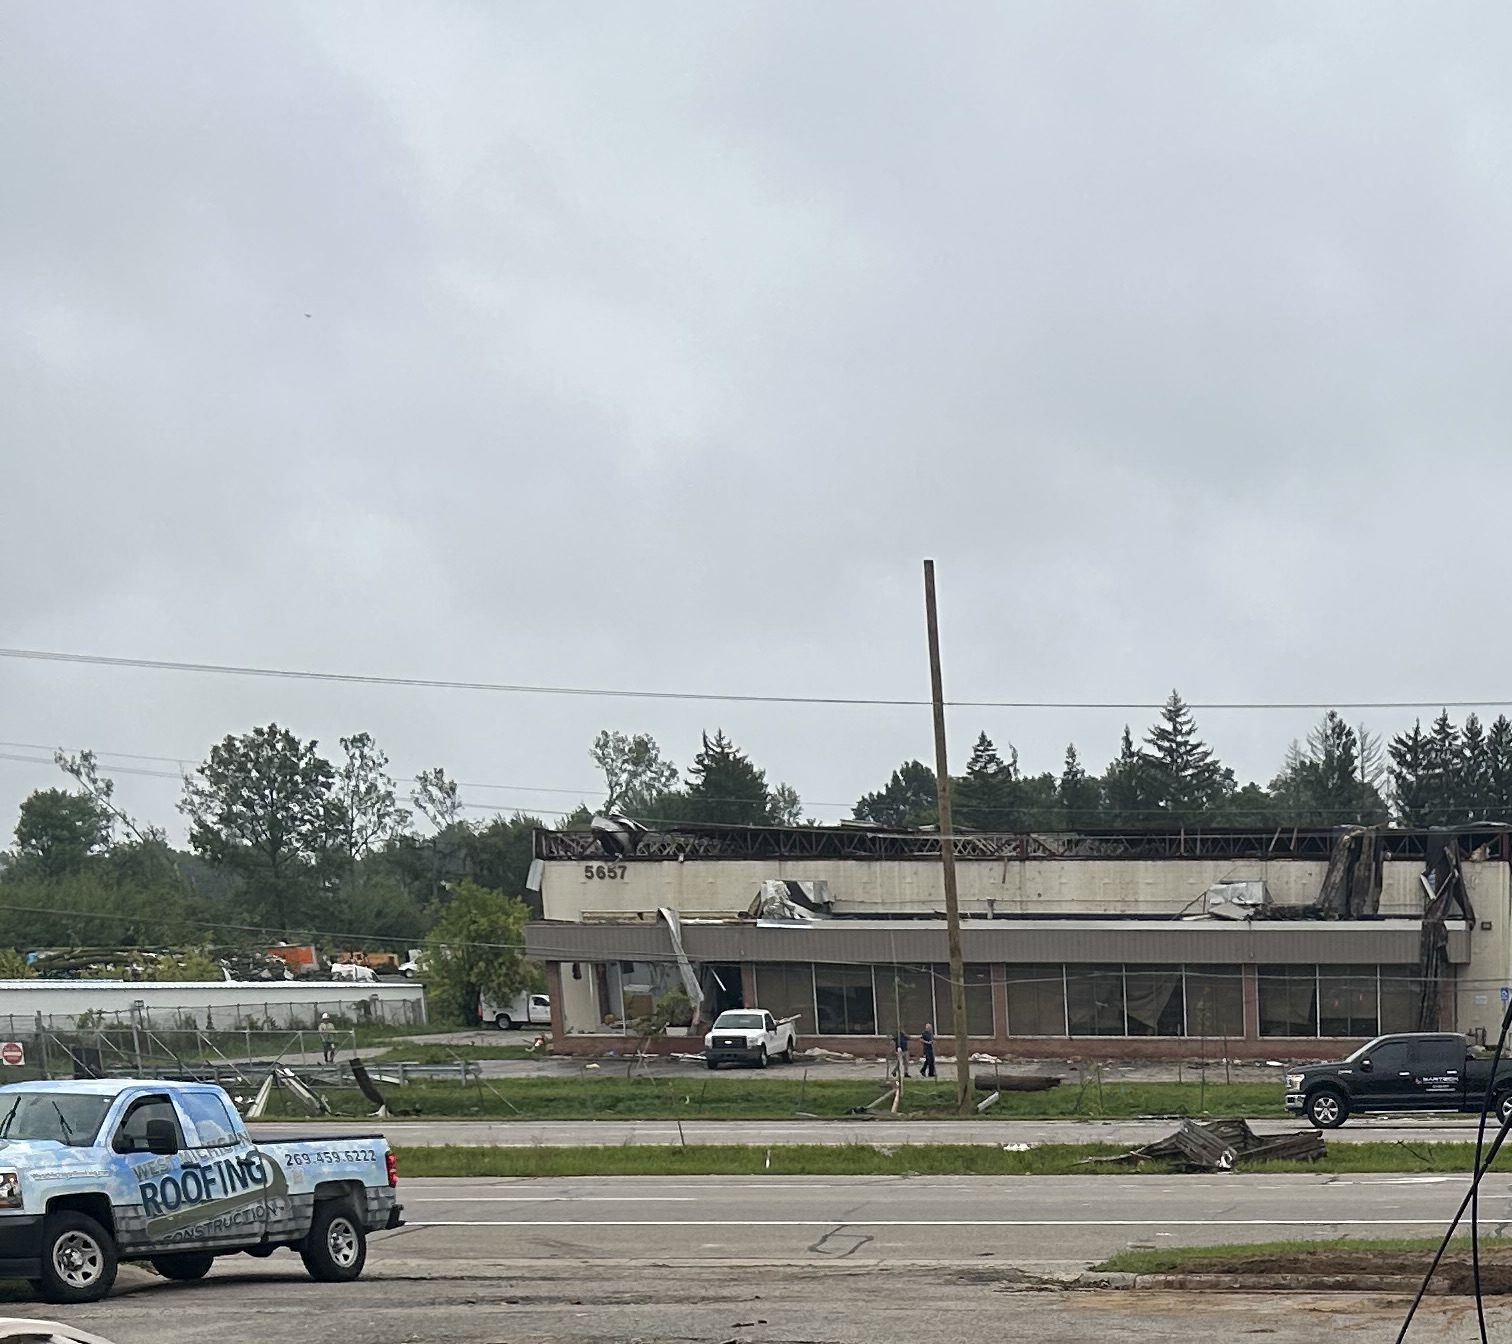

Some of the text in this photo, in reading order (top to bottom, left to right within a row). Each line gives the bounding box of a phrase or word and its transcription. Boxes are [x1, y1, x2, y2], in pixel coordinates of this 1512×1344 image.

[585, 865, 627, 880] 5657
[133, 1131, 251, 1182] WEST MICHIGAN
[285, 1150, 376, 1166] 269.459.6222
[139, 1150, 265, 1217] ROOFING
[163, 1204, 278, 1241] CONSTRUCTION
